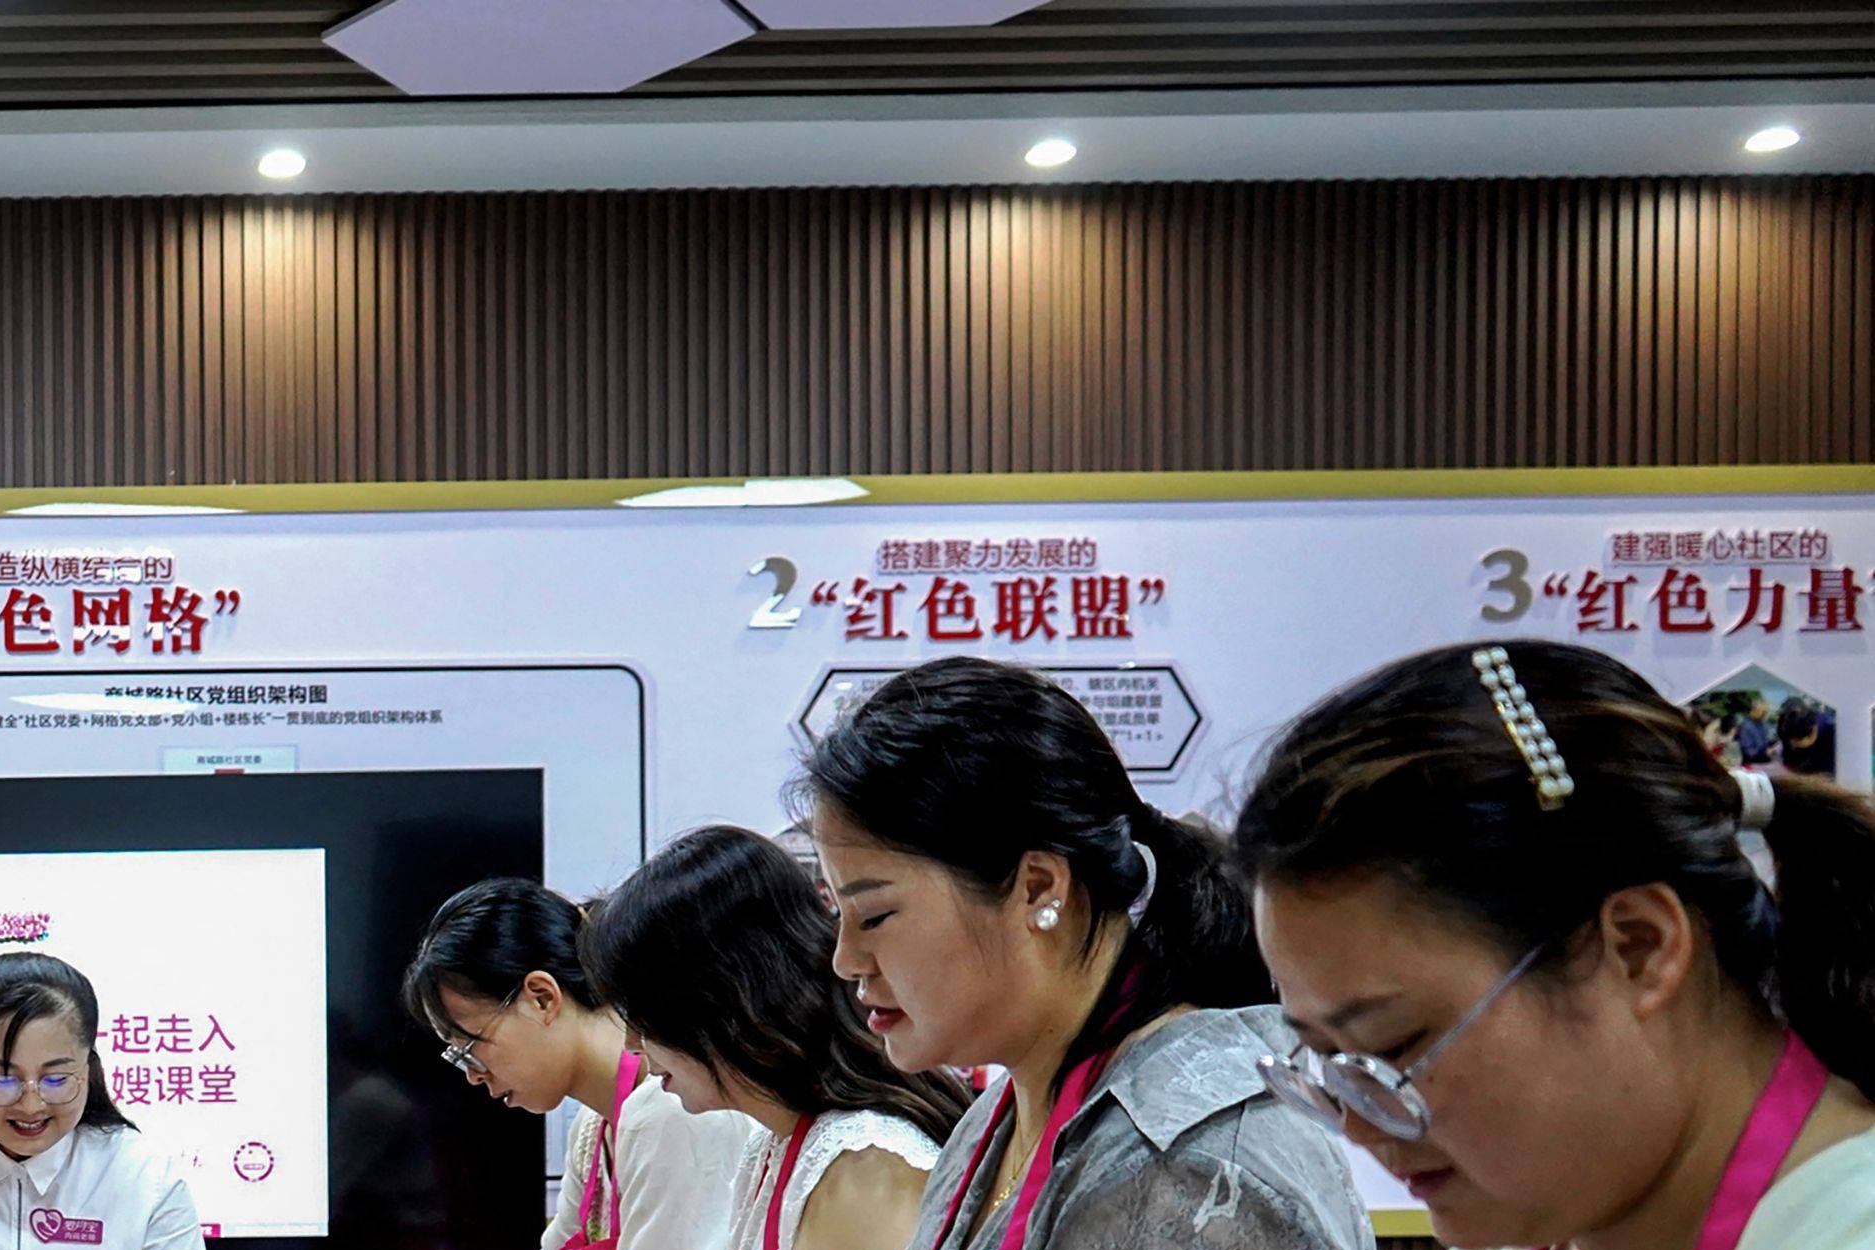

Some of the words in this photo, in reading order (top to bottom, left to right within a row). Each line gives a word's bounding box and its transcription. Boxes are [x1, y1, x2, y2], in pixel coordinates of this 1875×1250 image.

[882, 538, 1097, 569] 搭建聚力发展的
[1611, 530, 1828, 561] 建强暖心社区的
[748, 557, 802, 629] 2
[811, 574, 1166, 643] “红色联盟”
[1481, 549, 1533, 623] 3
